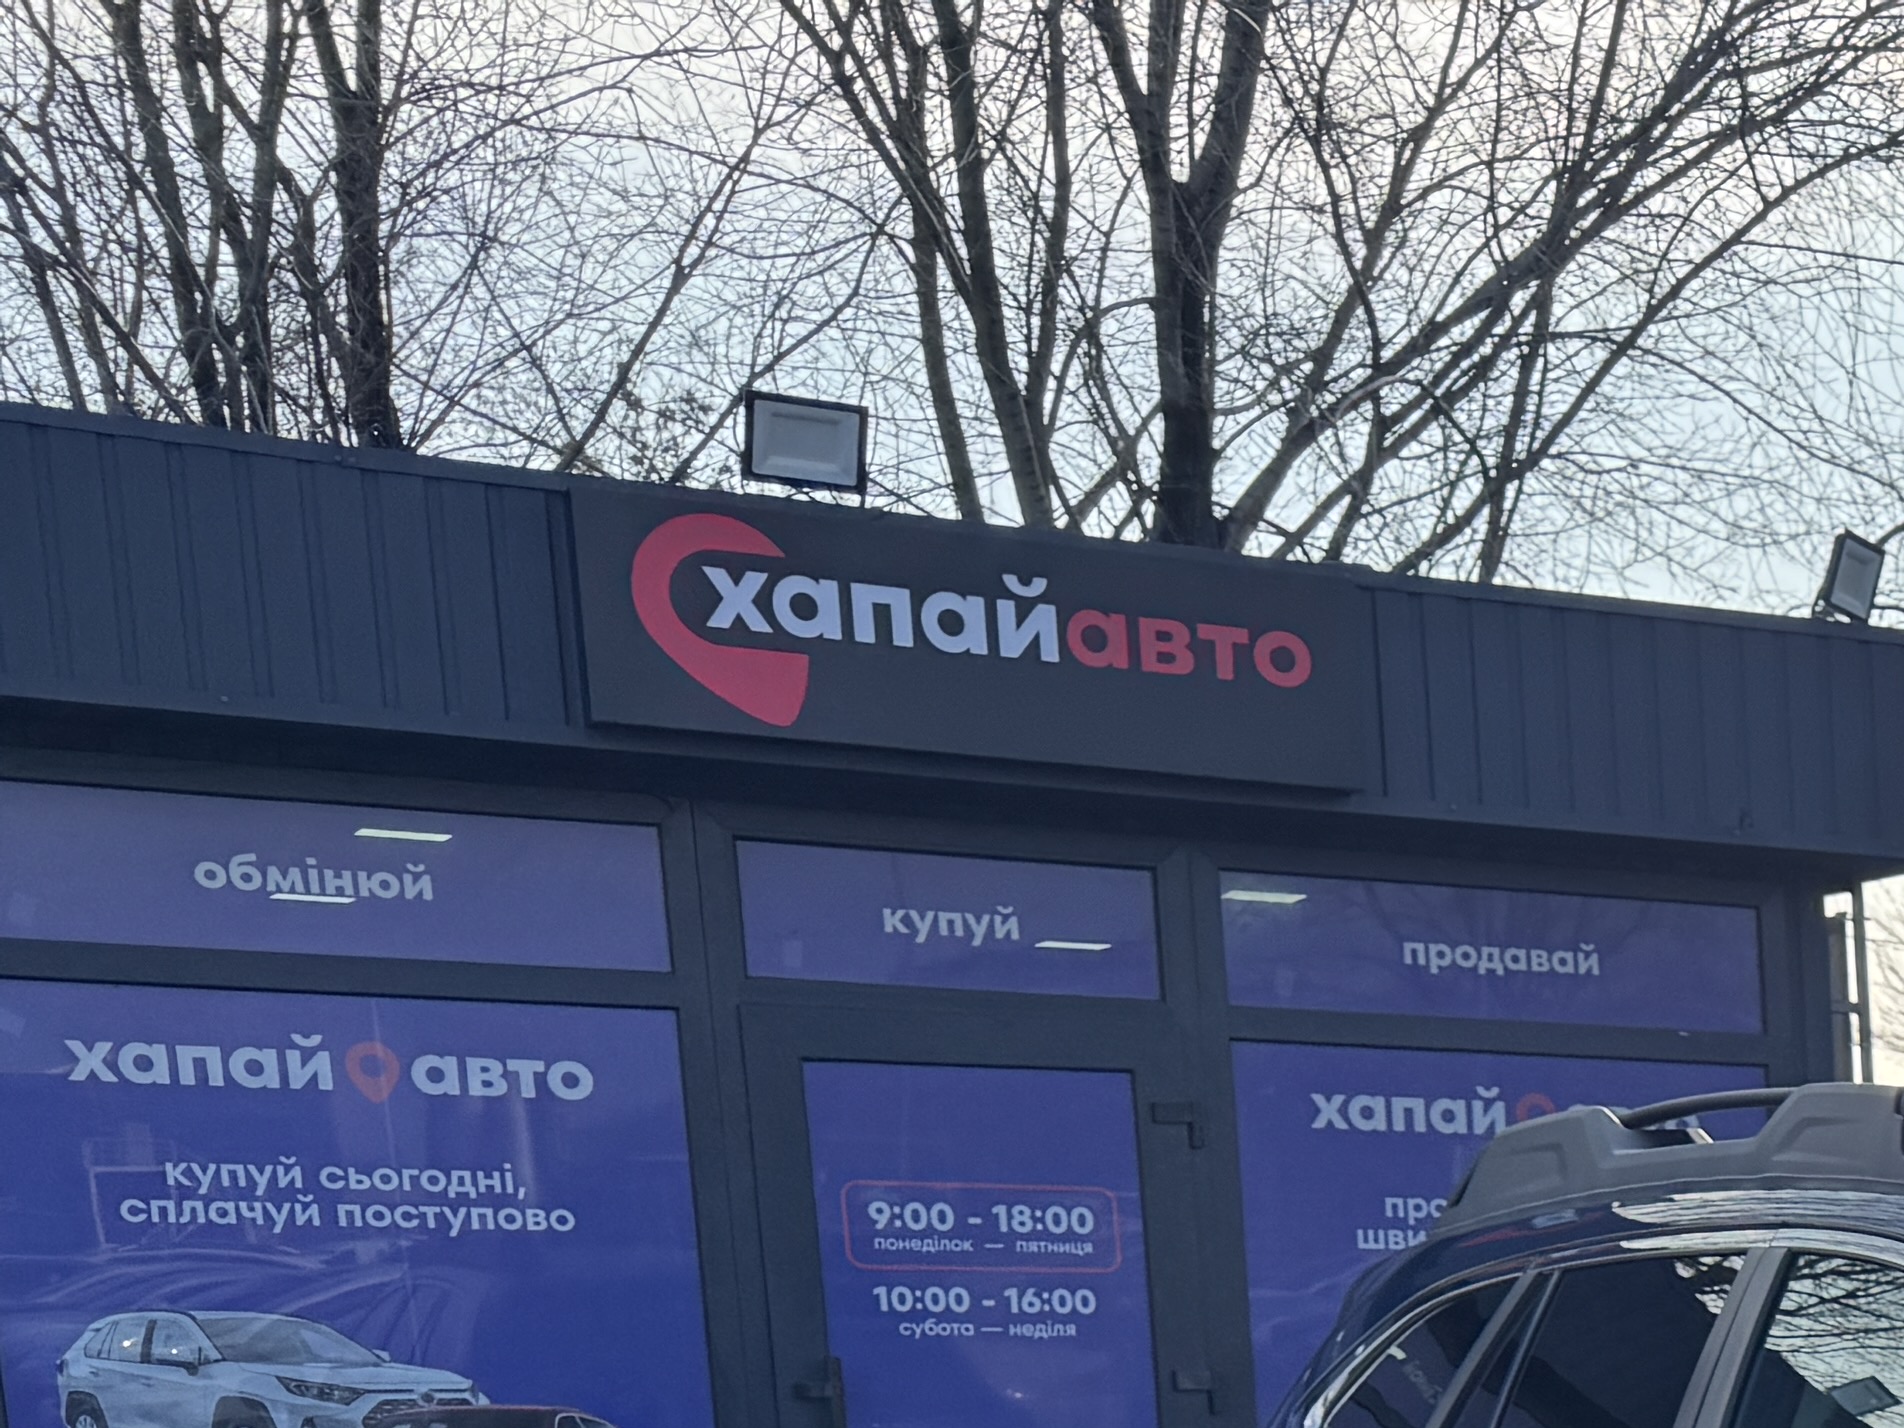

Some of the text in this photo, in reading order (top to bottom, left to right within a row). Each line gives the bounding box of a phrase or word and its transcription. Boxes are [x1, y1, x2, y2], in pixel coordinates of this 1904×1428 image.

[194, 853, 433, 901] обмінюй
[882, 904, 1020, 946] купуй
[1401, 936, 1601, 977] продавай
[64, 1033, 594, 1101] хапай авто
[1310, 1086, 1506, 1135] хапай
[165, 1156, 526, 1200] купуй сьогодні,
[119, 1195, 576, 1237] сплачуй поступово
[867, 1201, 955, 1231] 9:00
[991, 1204, 1094, 1234] 18:00
[873, 1235, 974, 1253] понеділок
[872, 1286, 971, 1313] 10:00
[1003, 1287, 1097, 1314] 16:00
[899, 1318, 975, 1339] субота
[1009, 1319, 1077, 1339] неділя
